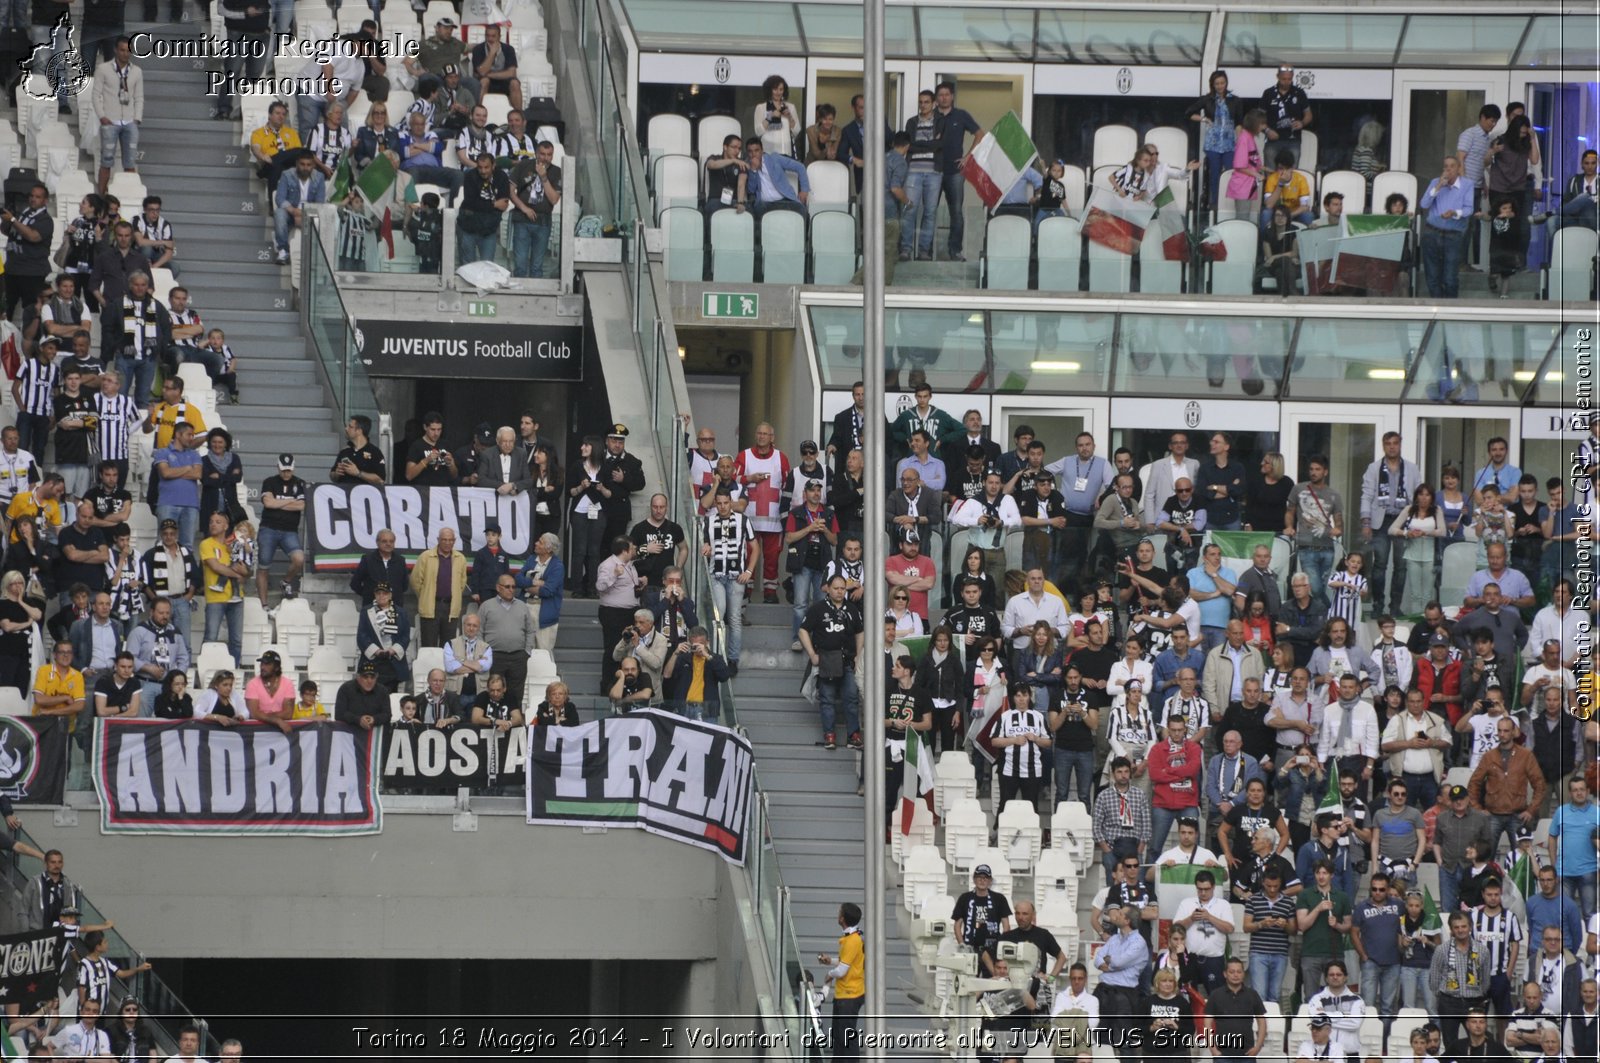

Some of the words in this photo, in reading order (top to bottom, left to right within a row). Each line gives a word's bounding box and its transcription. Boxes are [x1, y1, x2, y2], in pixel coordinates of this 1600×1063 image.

[193, 60, 205, 69] 29
[226, 154, 238, 164] 27
[241, 202, 253, 212] 26
[258, 250, 270, 260] 25
[274, 298, 286, 308] 24
[381, 337, 468, 356] JUVENTUS
[474, 340, 532, 359] Football
[537, 342, 571, 360] Club
[99, 412, 122, 423] Jeep
[313, 484, 532, 556] CORATO
[1008, 726, 1038, 734] SONY
[384, 726, 528, 777] AOSTA
[116, 729, 364, 815] ANDRIA
[545, 718, 751, 834] TRANI
